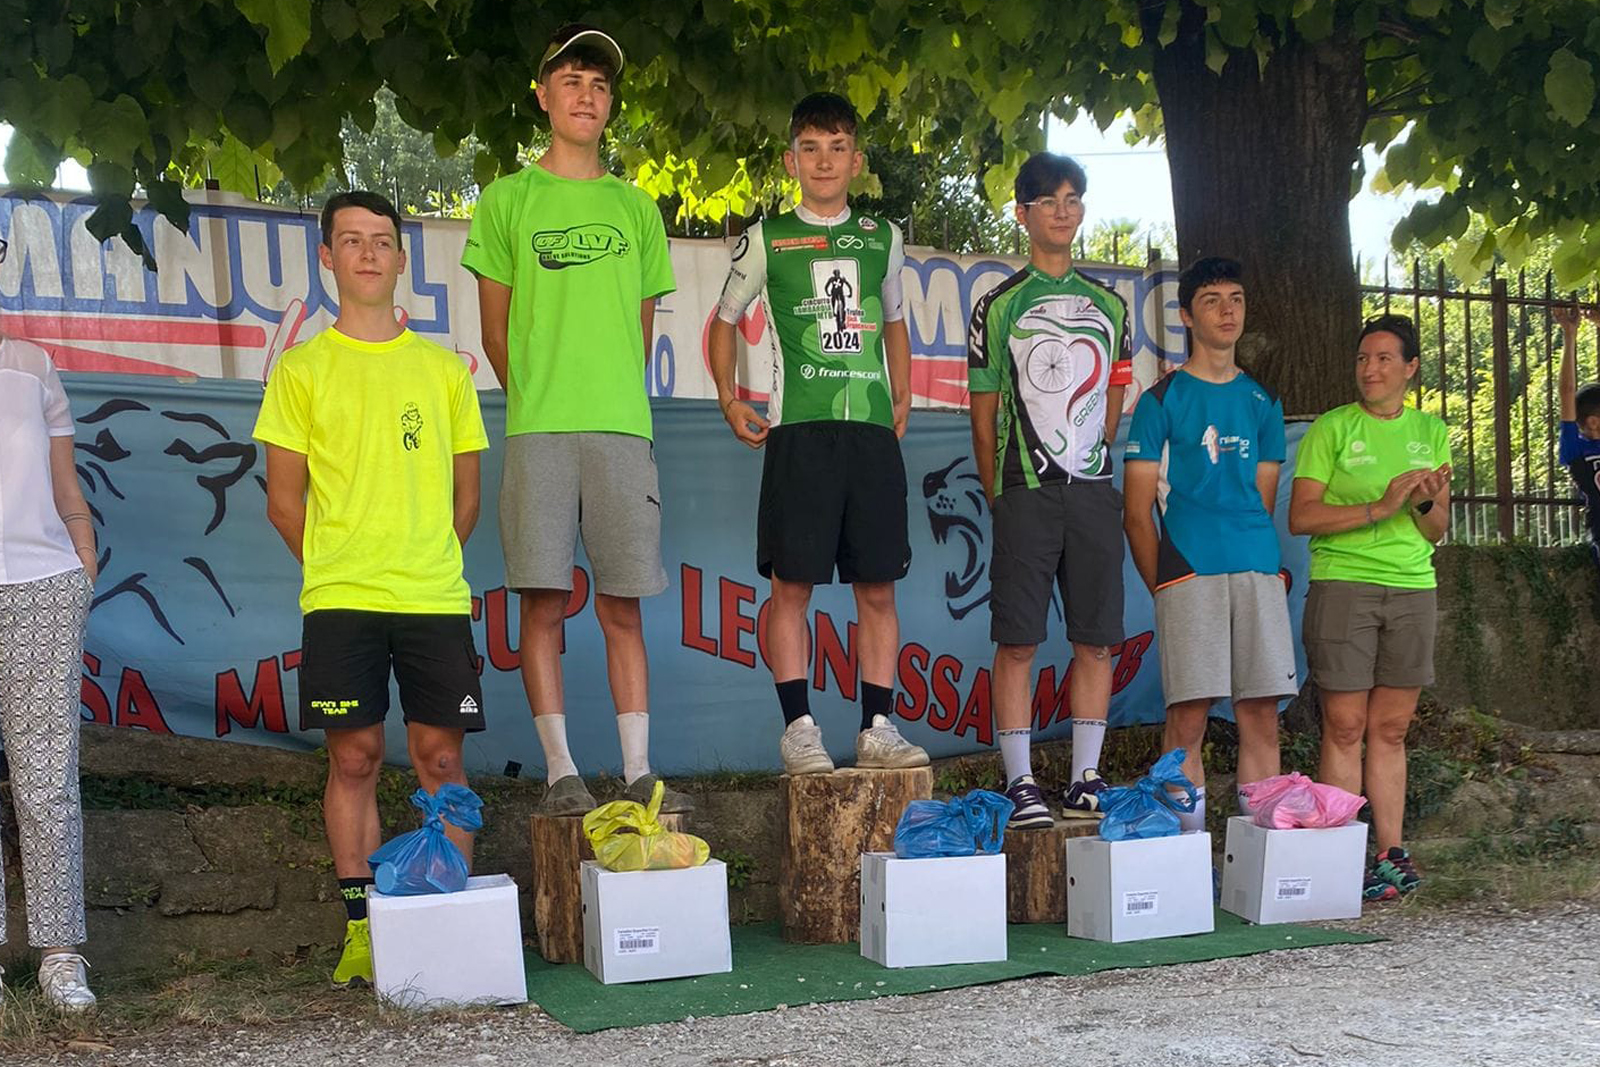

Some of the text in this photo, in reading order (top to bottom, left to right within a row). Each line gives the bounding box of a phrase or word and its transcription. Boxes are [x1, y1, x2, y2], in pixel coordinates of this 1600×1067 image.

[822, 332, 860, 350] 2024
[818, 367, 882, 380] francesconi
[1073, 388, 1102, 428] GREEN
[471, 565, 590, 677] UP
[681, 562, 995, 747] LENSSA
[1031, 630, 1154, 731] MB
